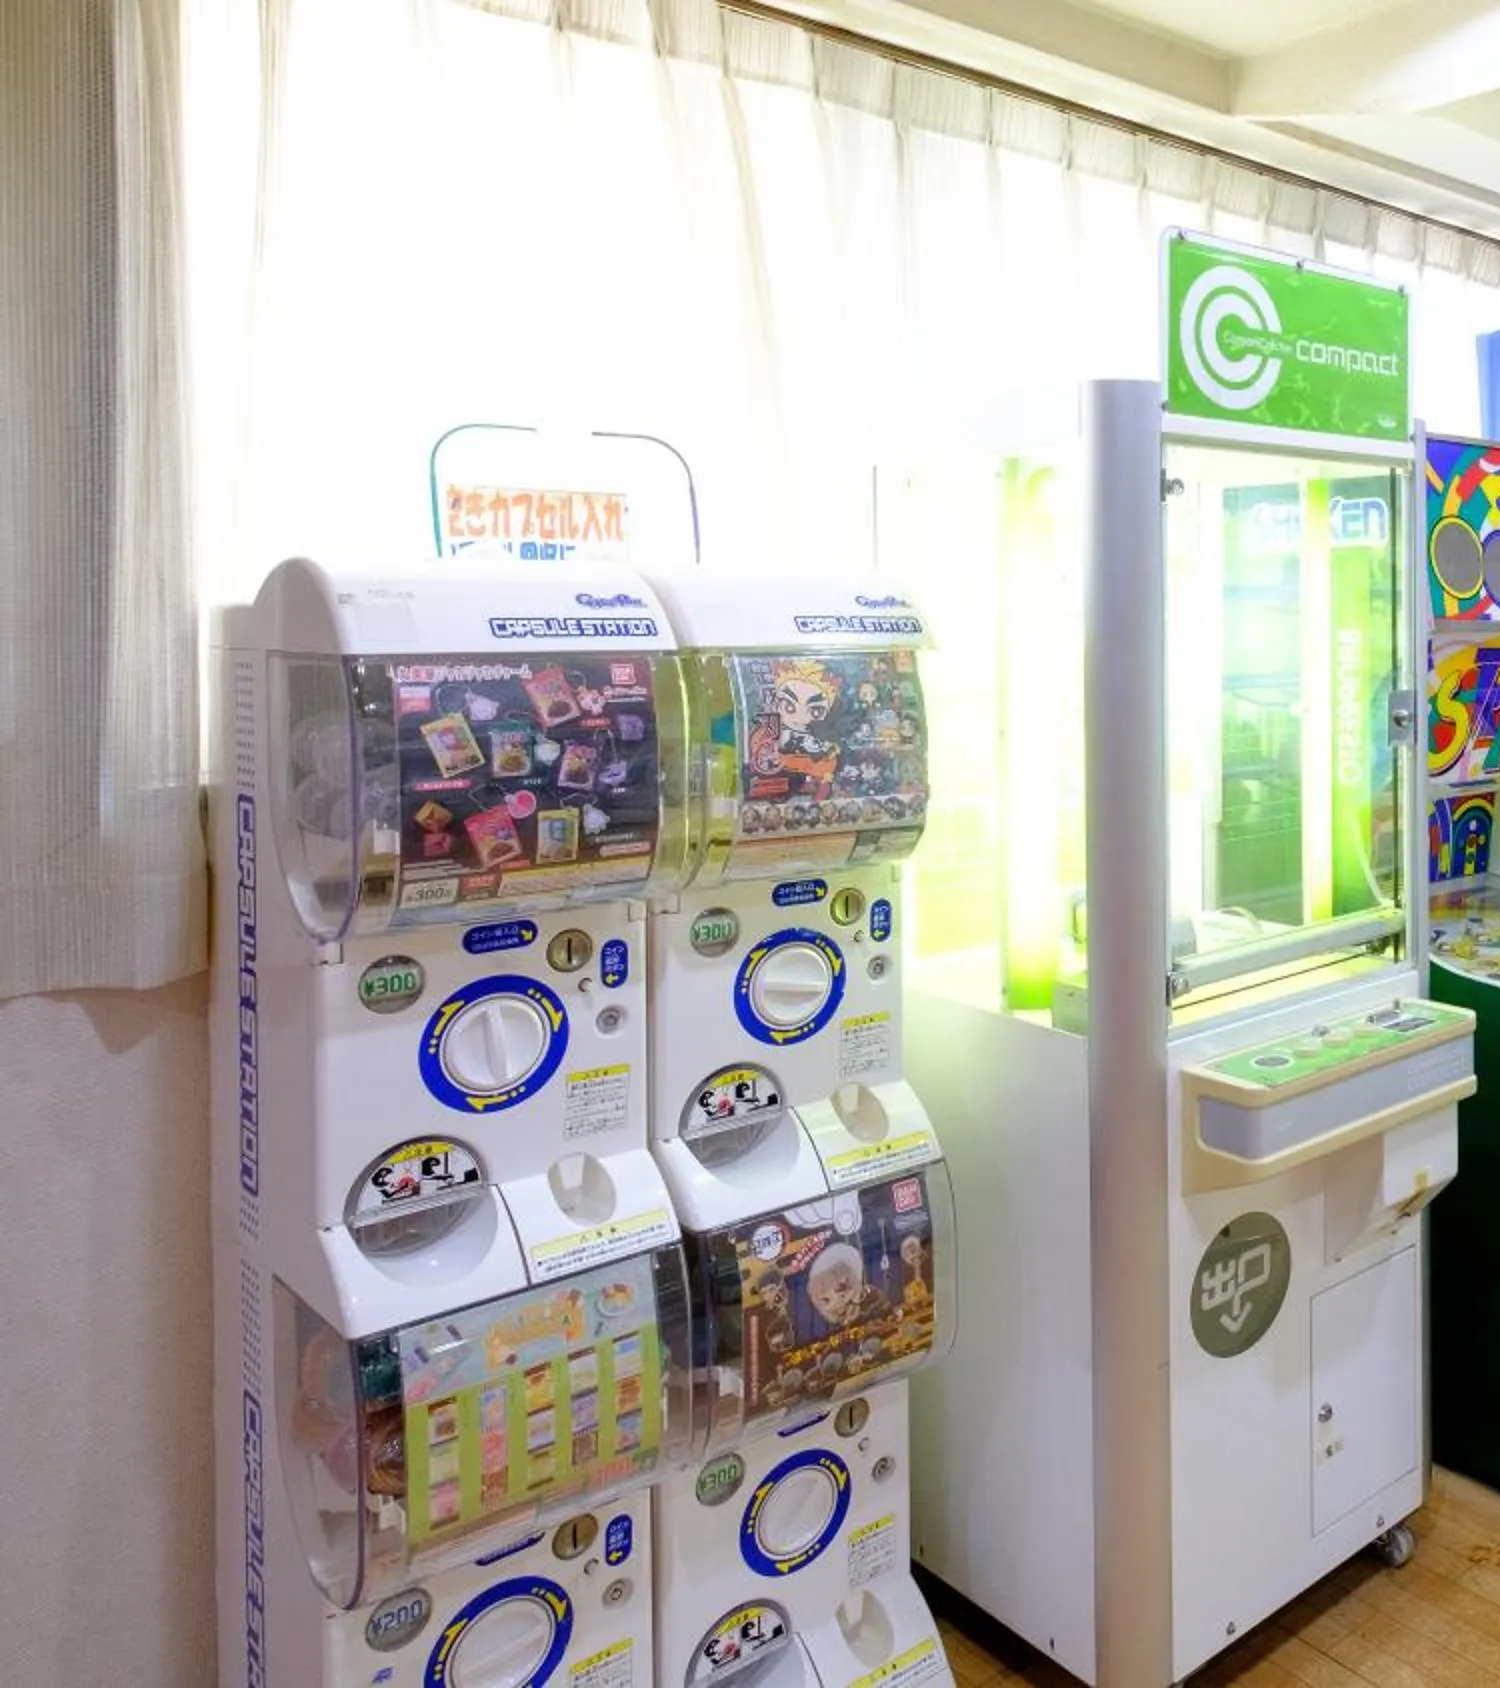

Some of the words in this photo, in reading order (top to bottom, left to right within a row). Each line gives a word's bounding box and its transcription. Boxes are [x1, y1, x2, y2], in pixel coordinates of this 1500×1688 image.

[1295, 339, 1399, 377] compact
[490, 616, 583, 637] CAPSULE
[580, 616, 659, 637] STATION
[794, 615, 866, 634] CAPSULE
[860, 615, 923, 634] STATION
[237, 793, 259, 1003] CAPSULE
[690, 921, 732, 941] ¥300
[363, 971, 417, 998] ¥300
[239, 1001, 260, 1198] STATION
[1201, 1242, 1271, 1312] 出口
[242, 1389, 265, 1598] CAPSULE
[699, 1464, 738, 1492] ¥300
[369, 1599, 424, 1637] ¥200
